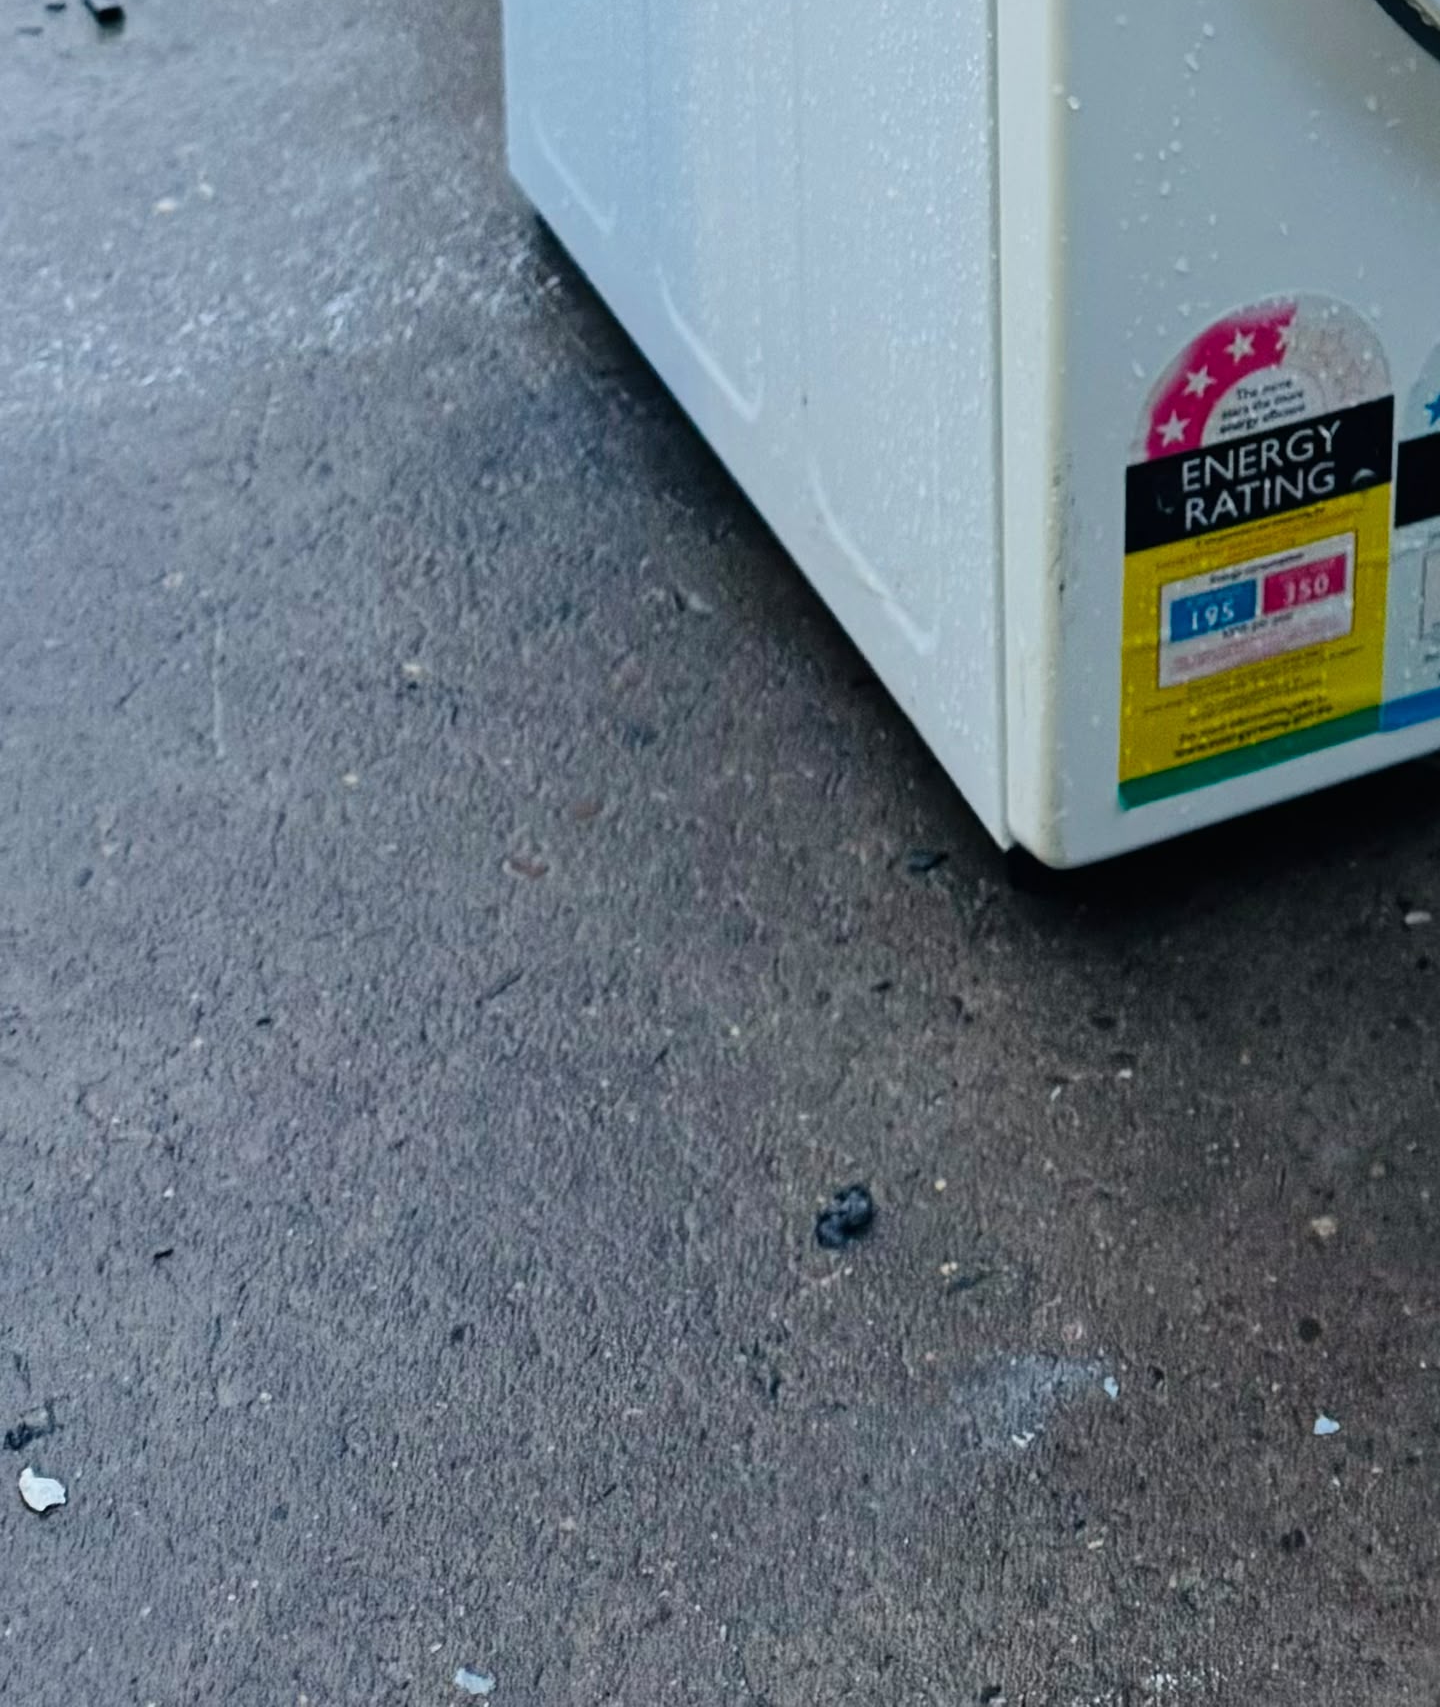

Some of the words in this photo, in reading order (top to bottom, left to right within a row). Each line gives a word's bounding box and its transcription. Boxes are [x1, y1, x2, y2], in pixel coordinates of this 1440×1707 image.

[1182, 420, 1341, 493] ENERGY
[1185, 461, 1335, 532] RATING
[1191, 601, 1235, 631] 195
